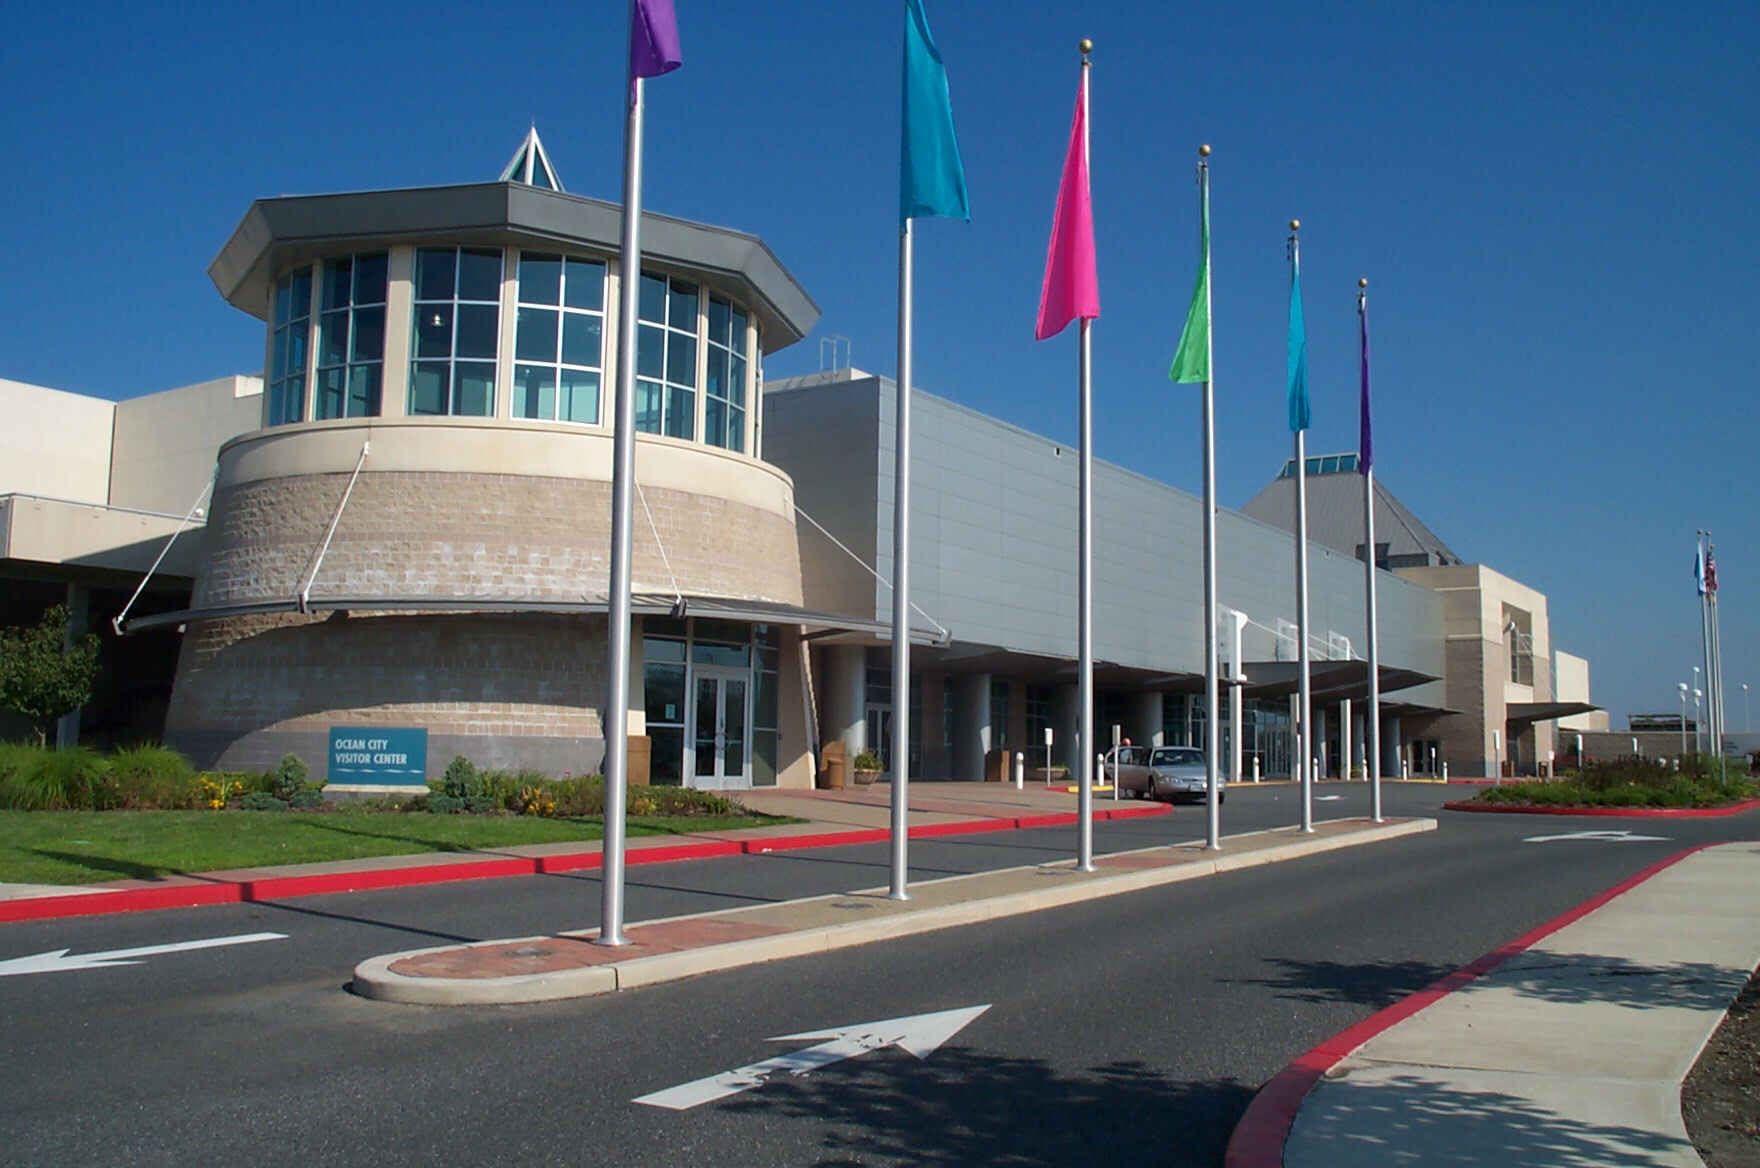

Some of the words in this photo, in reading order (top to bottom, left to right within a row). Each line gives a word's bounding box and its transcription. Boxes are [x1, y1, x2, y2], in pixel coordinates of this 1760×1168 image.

[335, 739, 366, 750] OCEAN
[368, 739, 389, 751] CITY
[335, 753, 372, 764] VISITOR
[374, 753, 408, 765] CENTER
